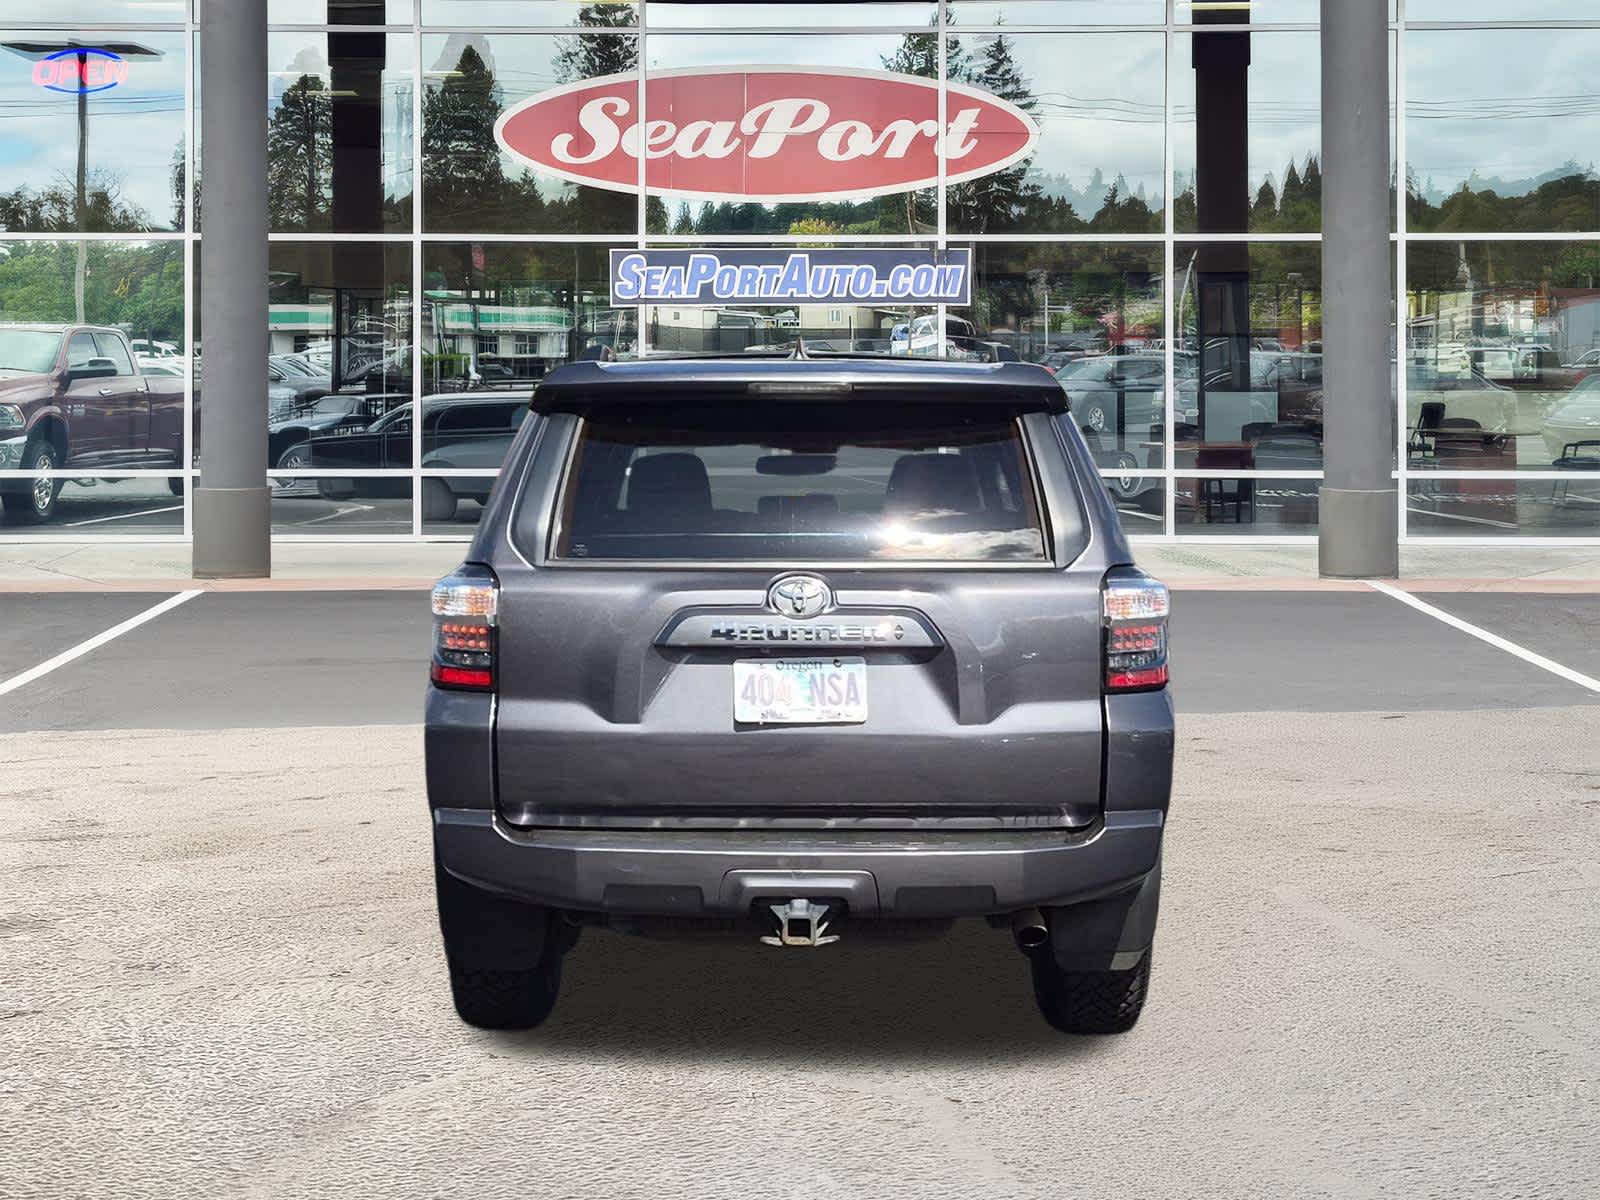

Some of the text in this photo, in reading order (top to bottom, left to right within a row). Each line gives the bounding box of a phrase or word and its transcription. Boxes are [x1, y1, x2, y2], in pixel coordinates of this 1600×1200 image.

[32, 60, 128, 86] OPEN
[551, 96, 982, 164] SeaPort
[775, 660, 822, 673] Oregon
[809, 672, 861, 706] NSA
